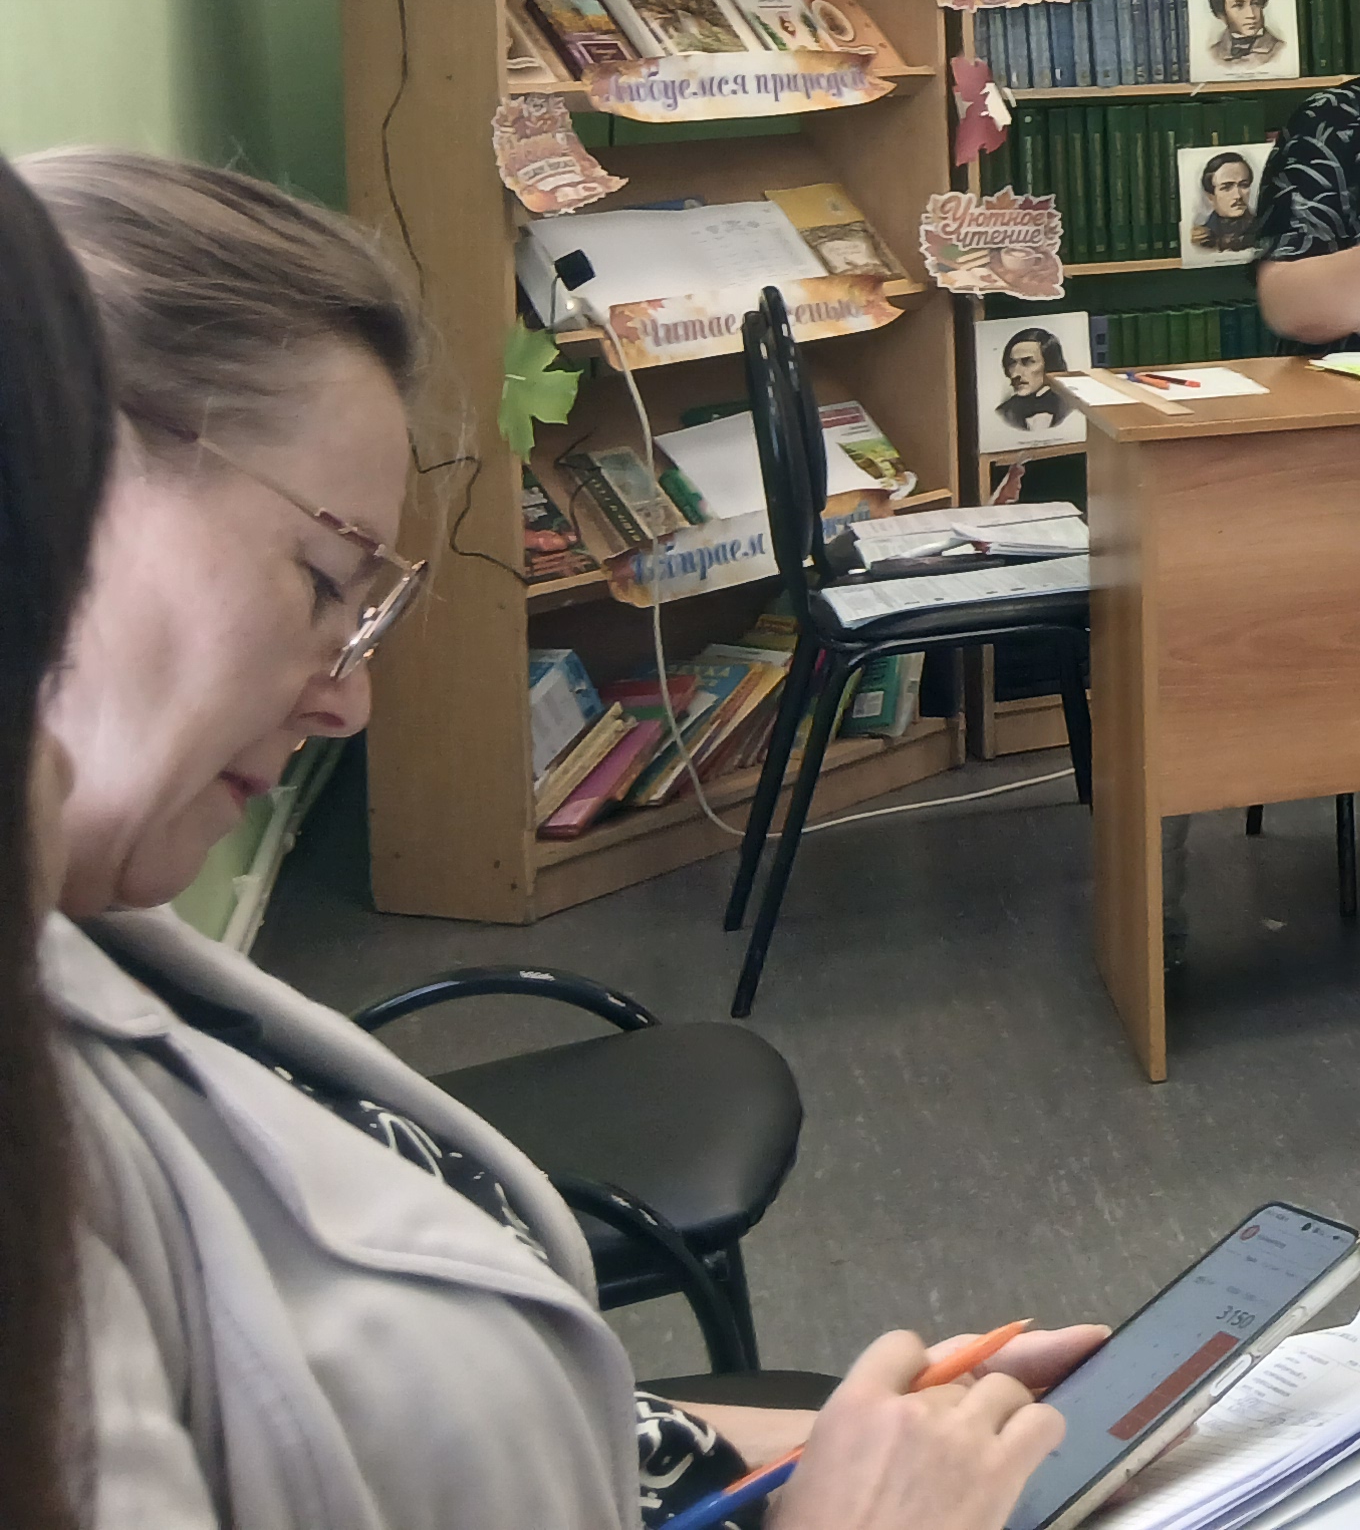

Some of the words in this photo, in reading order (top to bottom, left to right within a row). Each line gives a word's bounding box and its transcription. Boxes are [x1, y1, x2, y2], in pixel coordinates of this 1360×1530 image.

[940, 196, 1042, 236] Уютное
[957, 229, 1041, 248] чтение
[640, 313, 737, 347] Читае
